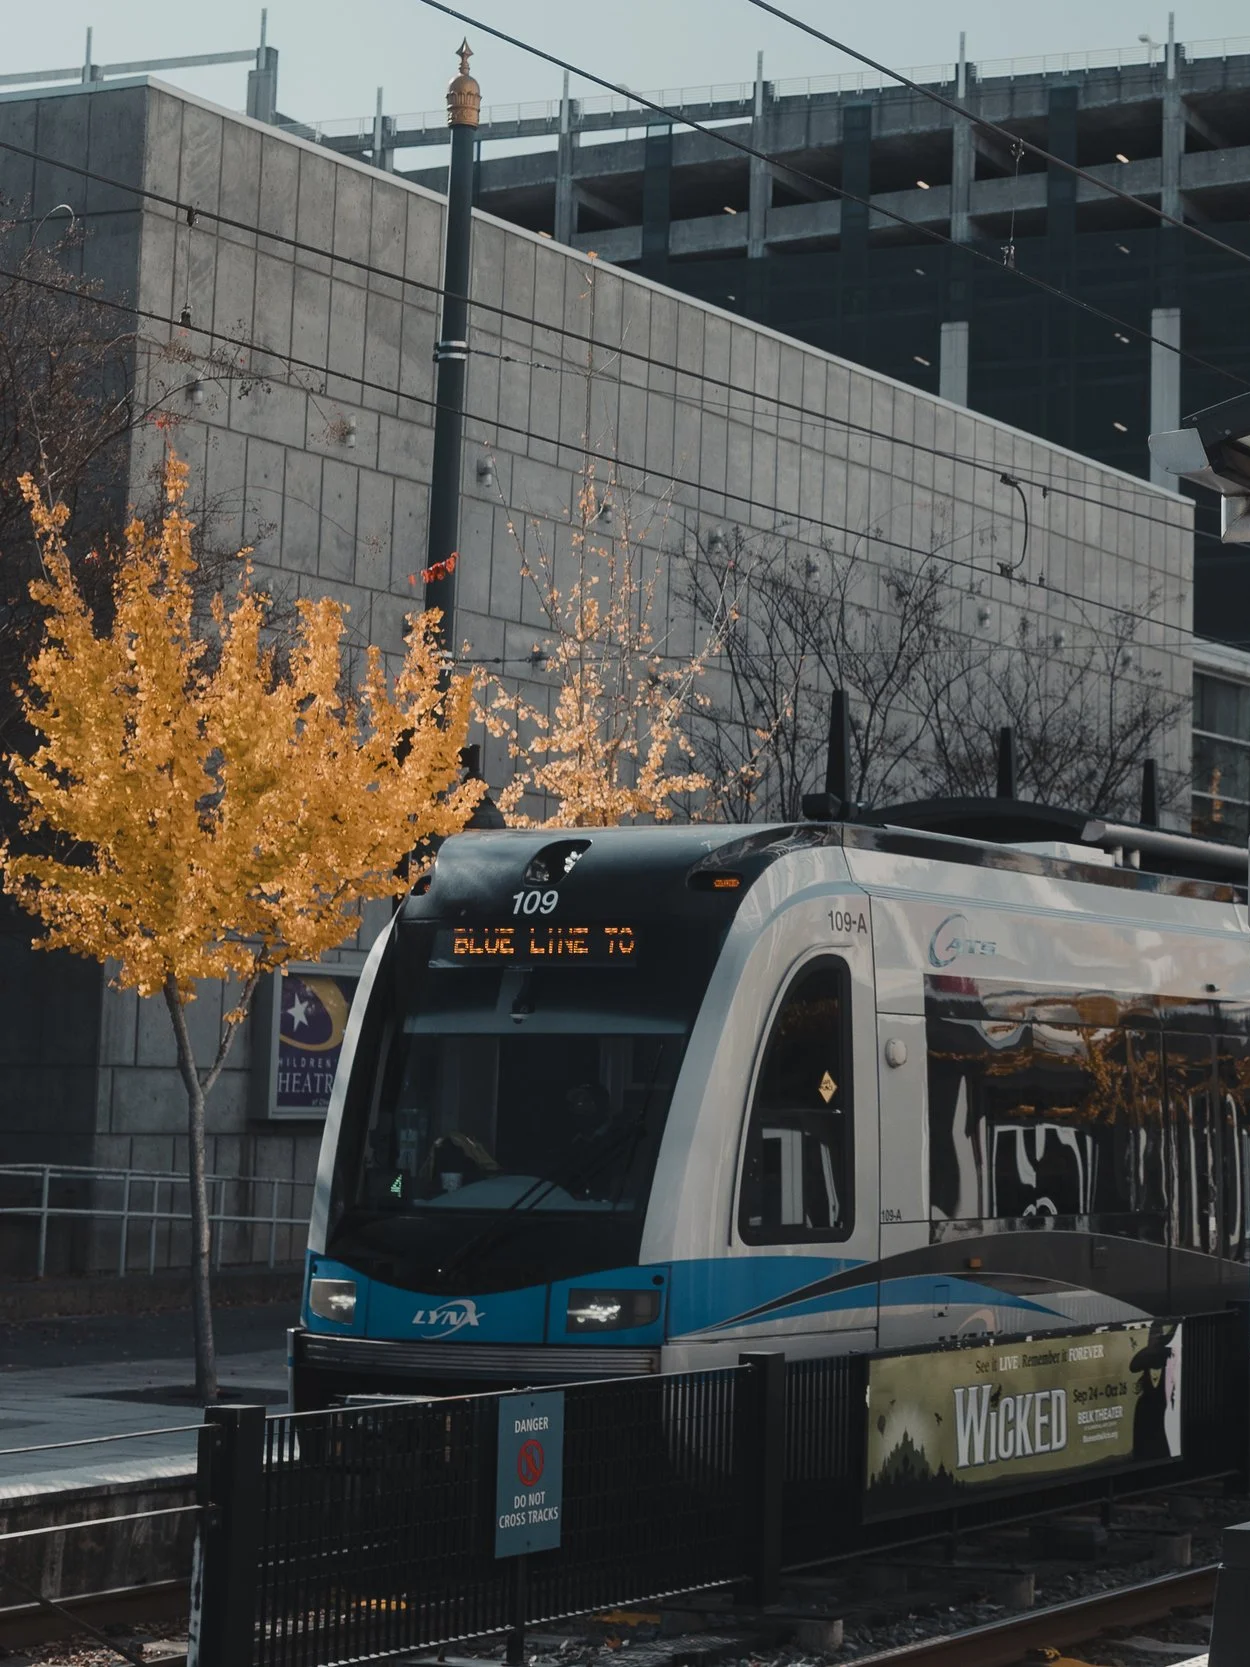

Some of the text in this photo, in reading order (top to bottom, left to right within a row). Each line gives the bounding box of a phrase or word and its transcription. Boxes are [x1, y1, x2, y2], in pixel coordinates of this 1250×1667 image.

[512, 890, 559, 915] 109
[828, 909, 867, 934] 109-A
[453, 927, 635, 954] BLUE LINE TO
[278, 1072, 334, 1094] HEATR
[880, 1209, 902, 1221] 109-A
[412, 1300, 486, 1335] LYNX
[976, 1360, 989, 1374] See
[1022, 1349, 1060, 1368] Remember
[1068, 1344, 1104, 1362] FOREVER
[1073, 1388, 1087, 1405] Sep
[1105, 1383, 1118, 1398] Oct
[514, 1416, 549, 1433] DANGER
[514, 1491, 546, 1509] DO NOT
[499, 1506, 559, 1529] CROSS TRACKS
